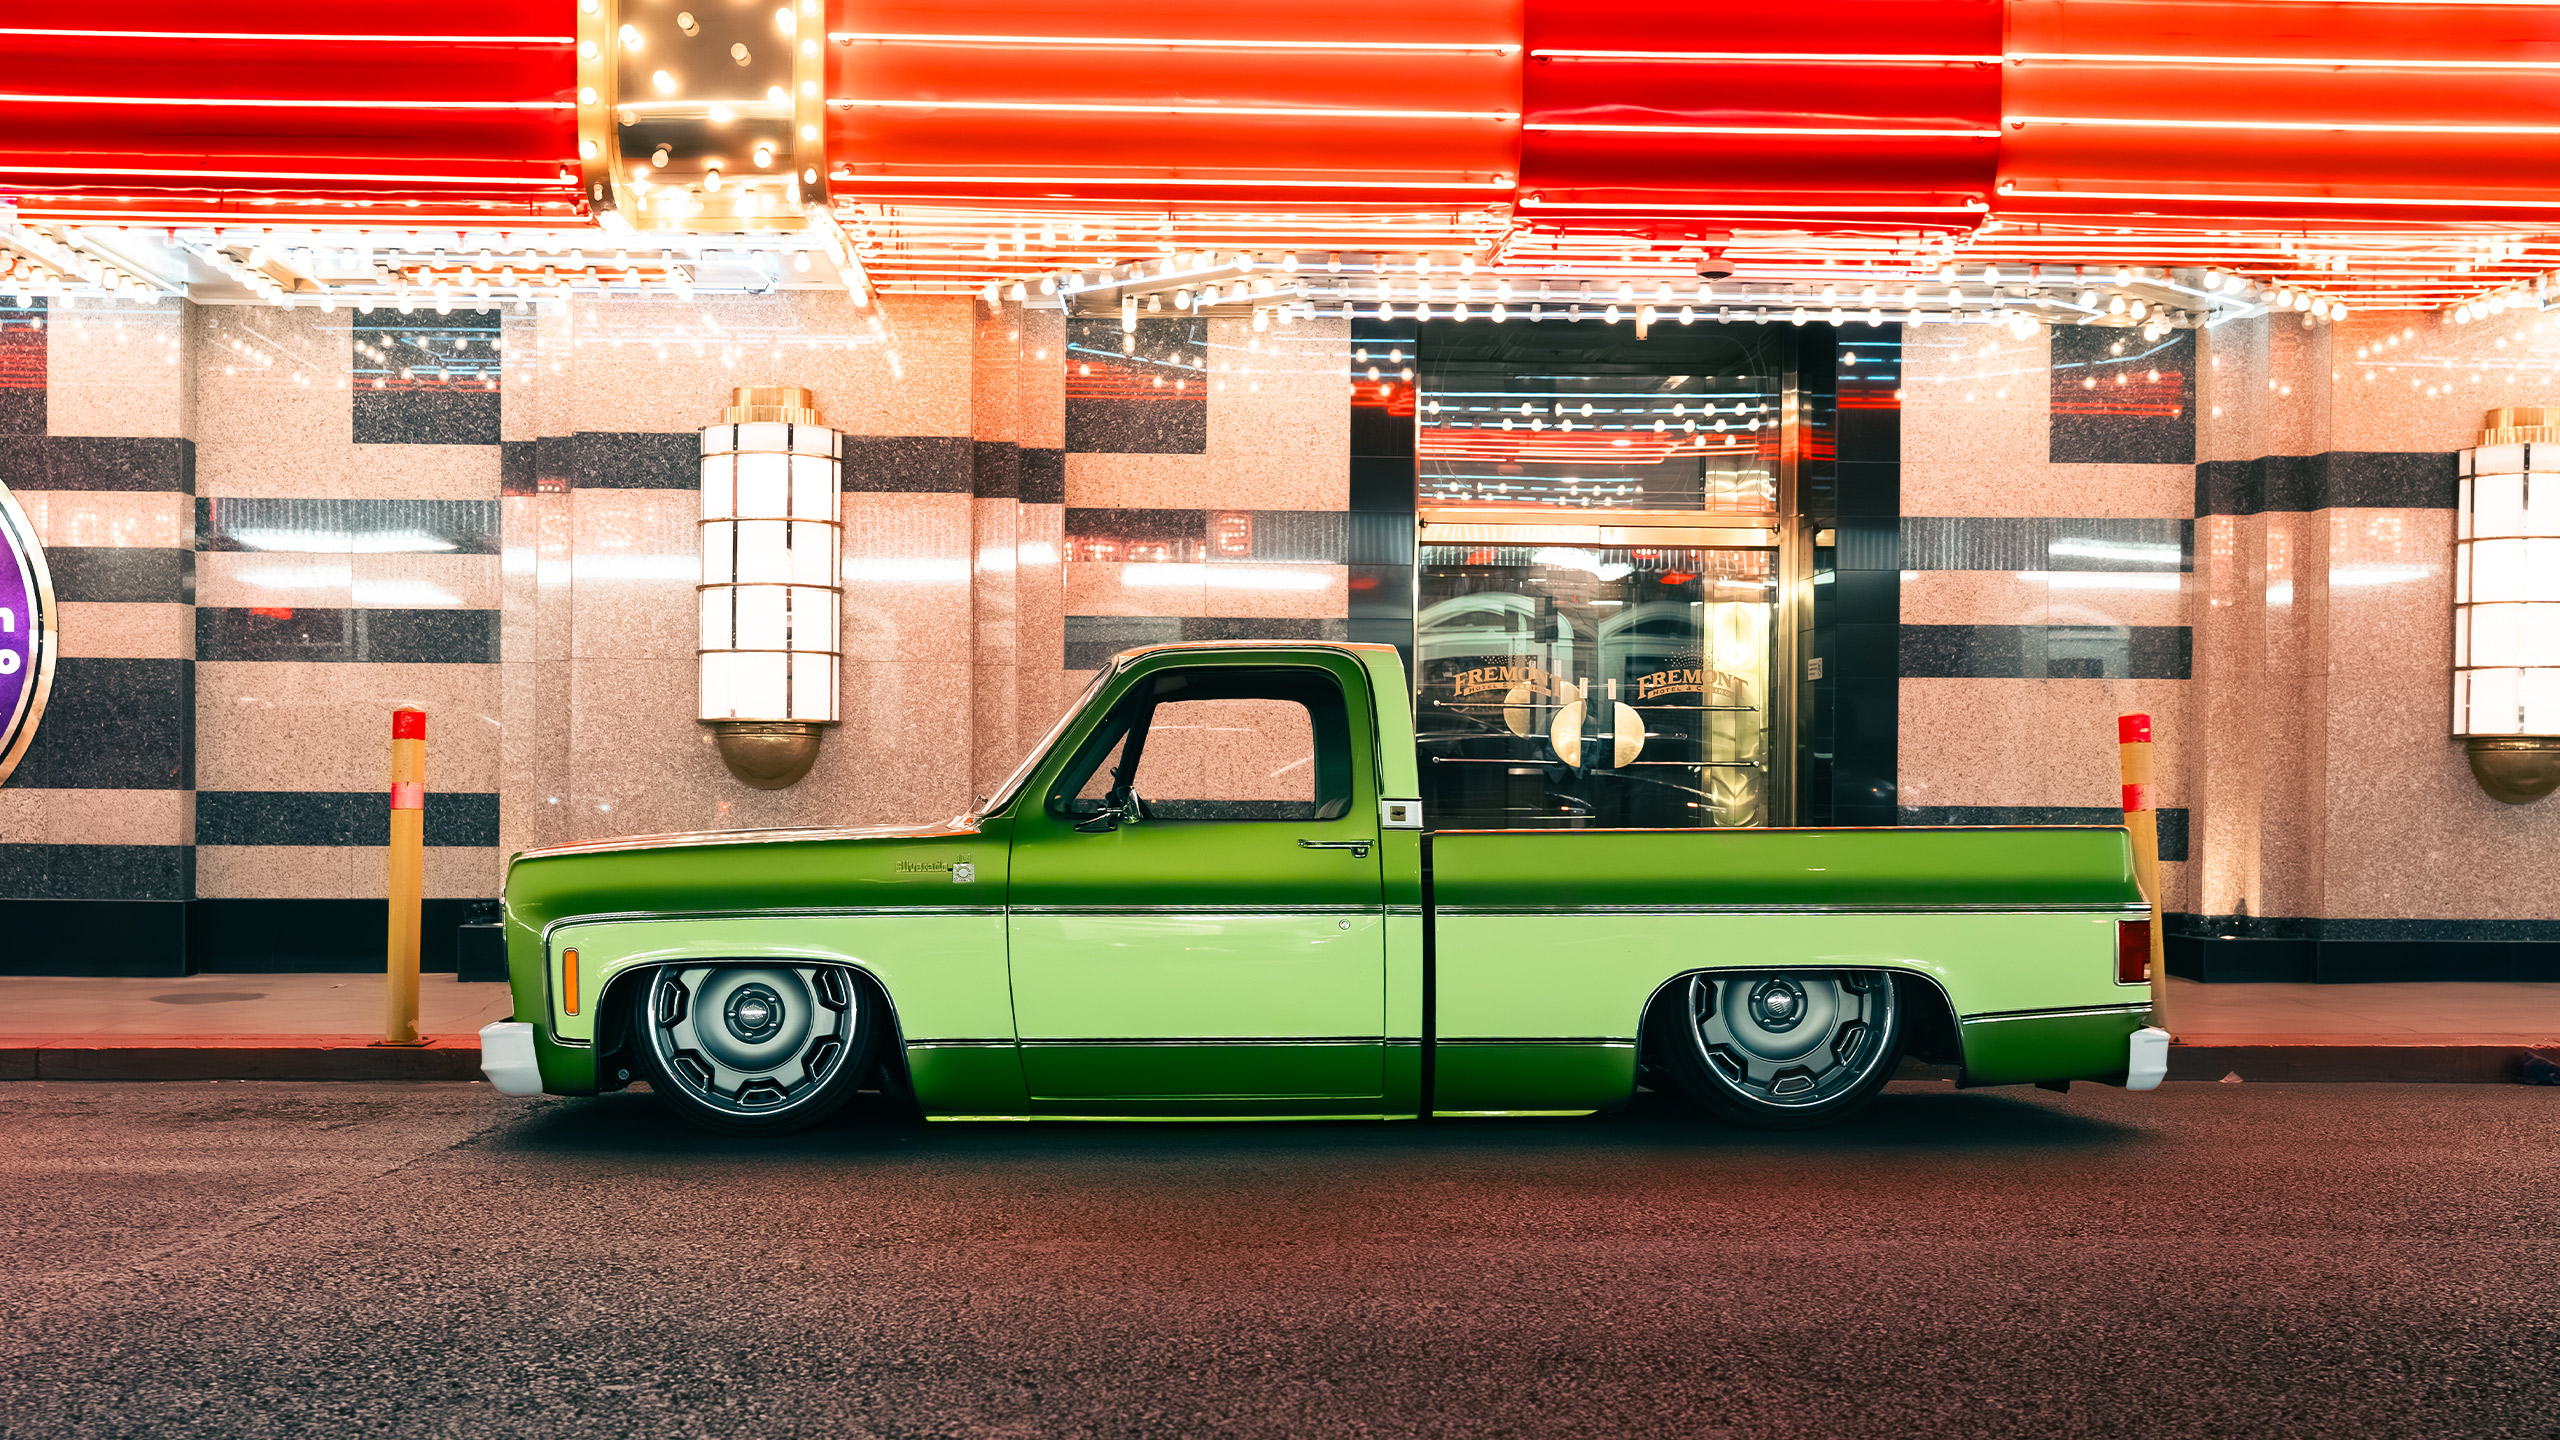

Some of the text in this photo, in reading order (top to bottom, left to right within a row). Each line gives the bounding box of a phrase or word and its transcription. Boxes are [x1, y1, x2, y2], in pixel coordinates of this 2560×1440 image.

[1453, 666, 1560, 697] FREMONT
[1637, 669, 1749, 700] FREMONT
[1652, 685, 1681, 696] HOTEL
